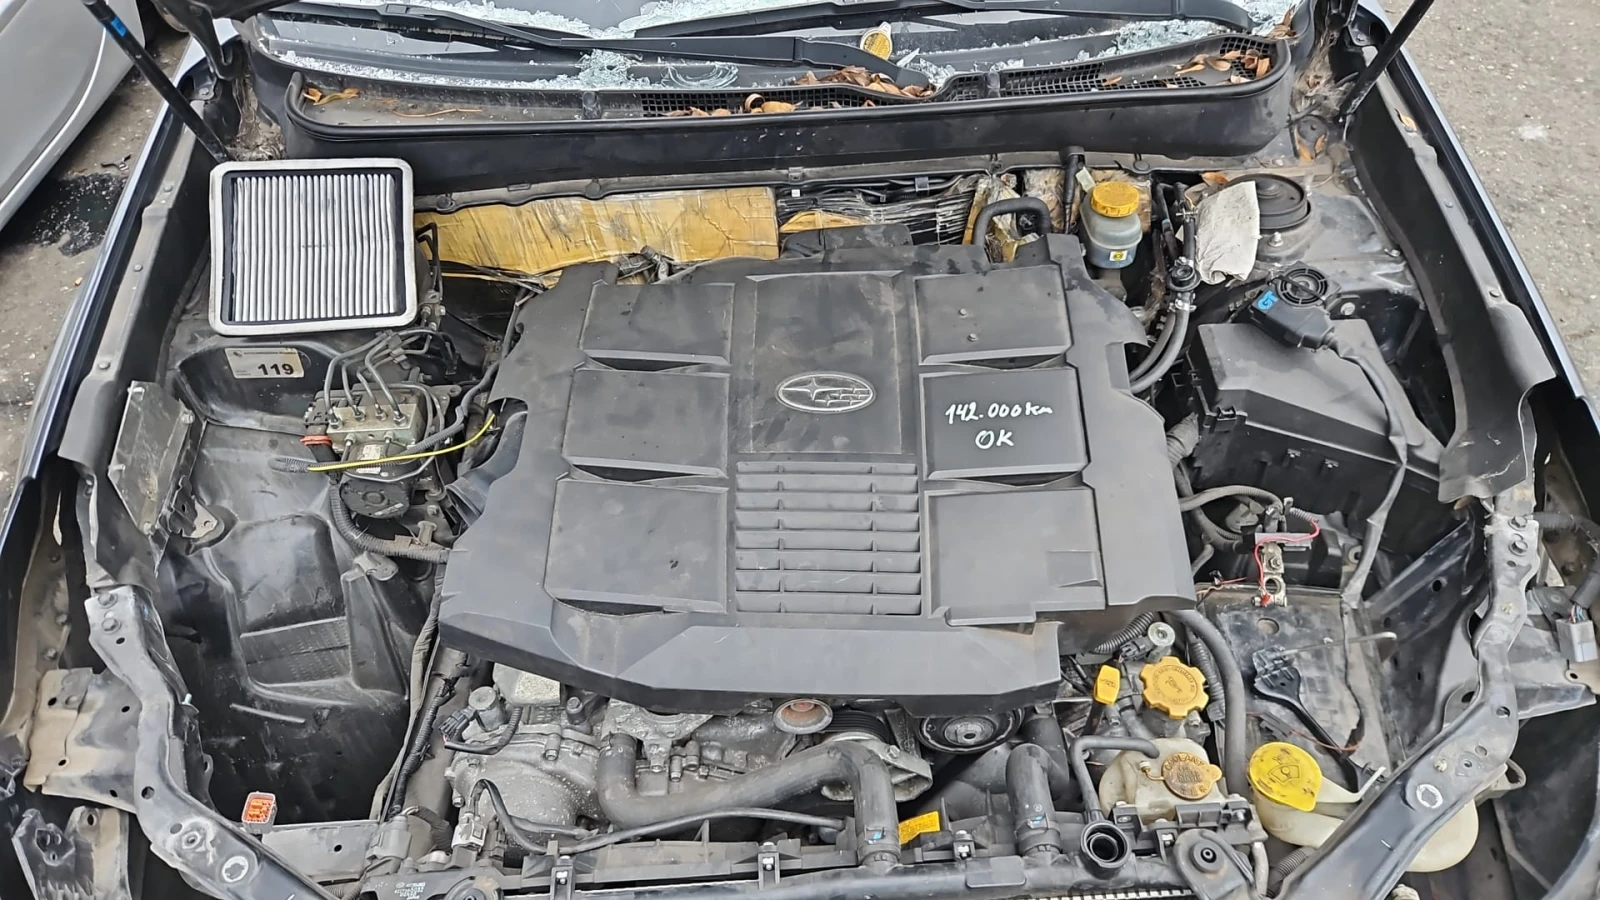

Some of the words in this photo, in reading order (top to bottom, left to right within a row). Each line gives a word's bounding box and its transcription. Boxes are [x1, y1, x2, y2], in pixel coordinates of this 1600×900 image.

[257, 363, 294, 375] 119
[974, 429, 1014, 449] OK
[1164, 753, 1205, 771] COOLANT
